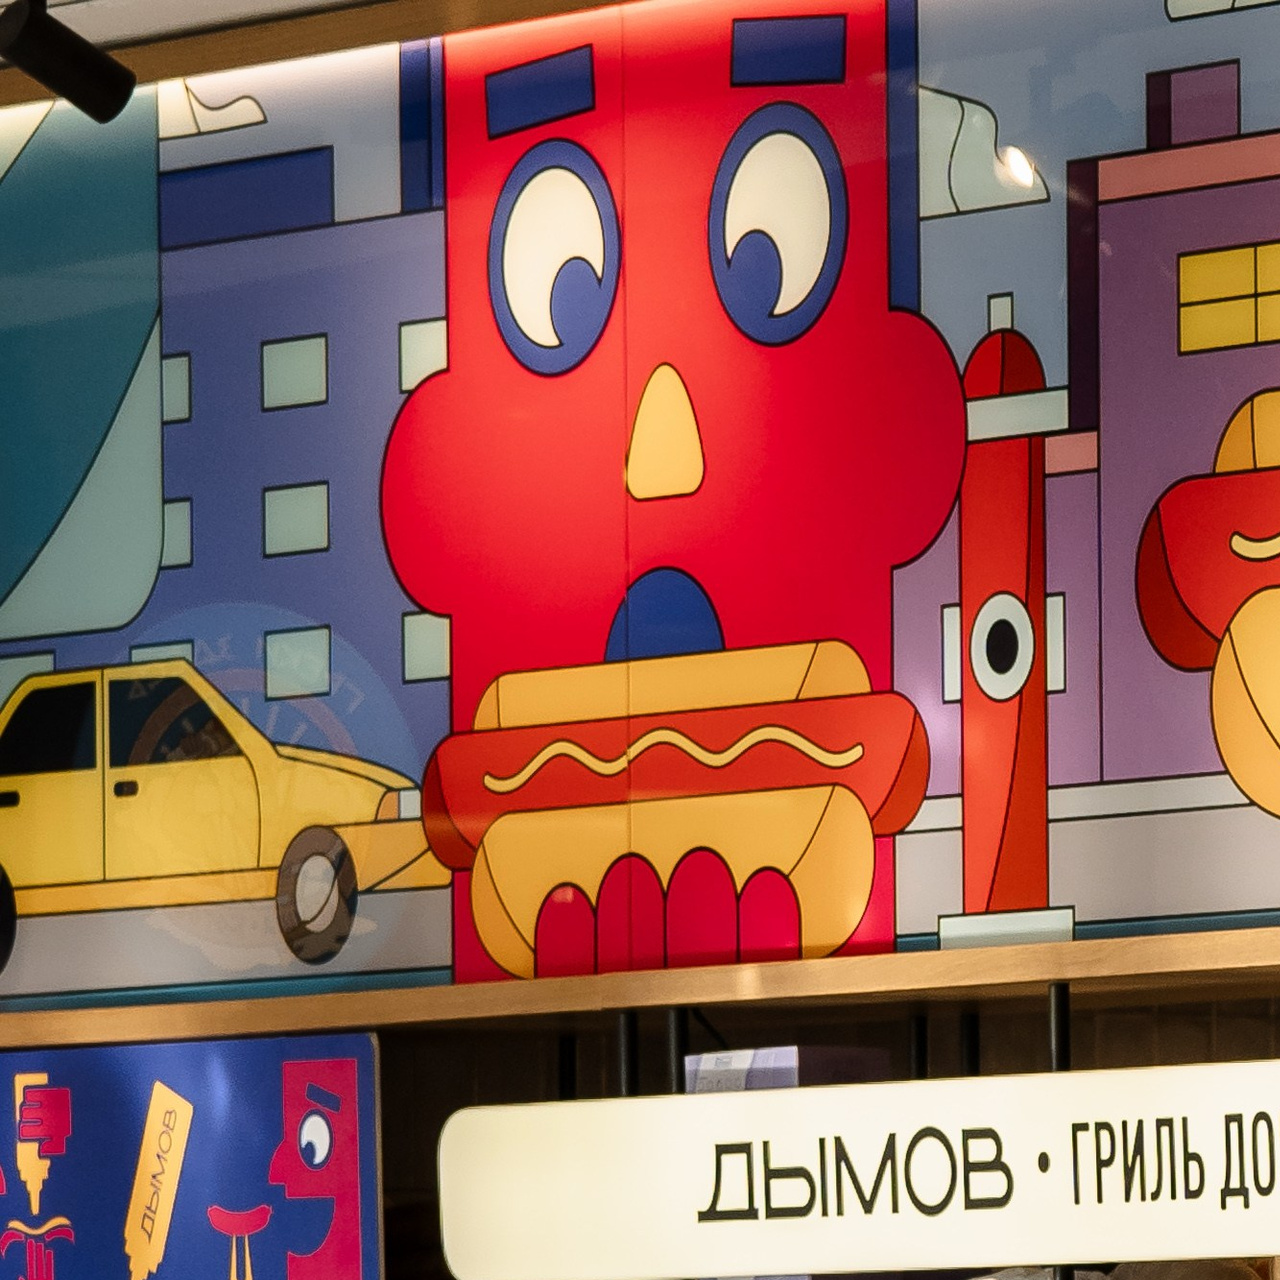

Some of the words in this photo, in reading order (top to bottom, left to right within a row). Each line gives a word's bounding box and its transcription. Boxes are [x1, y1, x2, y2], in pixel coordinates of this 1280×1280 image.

[139, 1108, 178, 1244] ДЫМОВ
[697, 1125, 1015, 1223] ДЫМОВ
[1070, 1115, 1206, 1206] ГРИЛЬ
